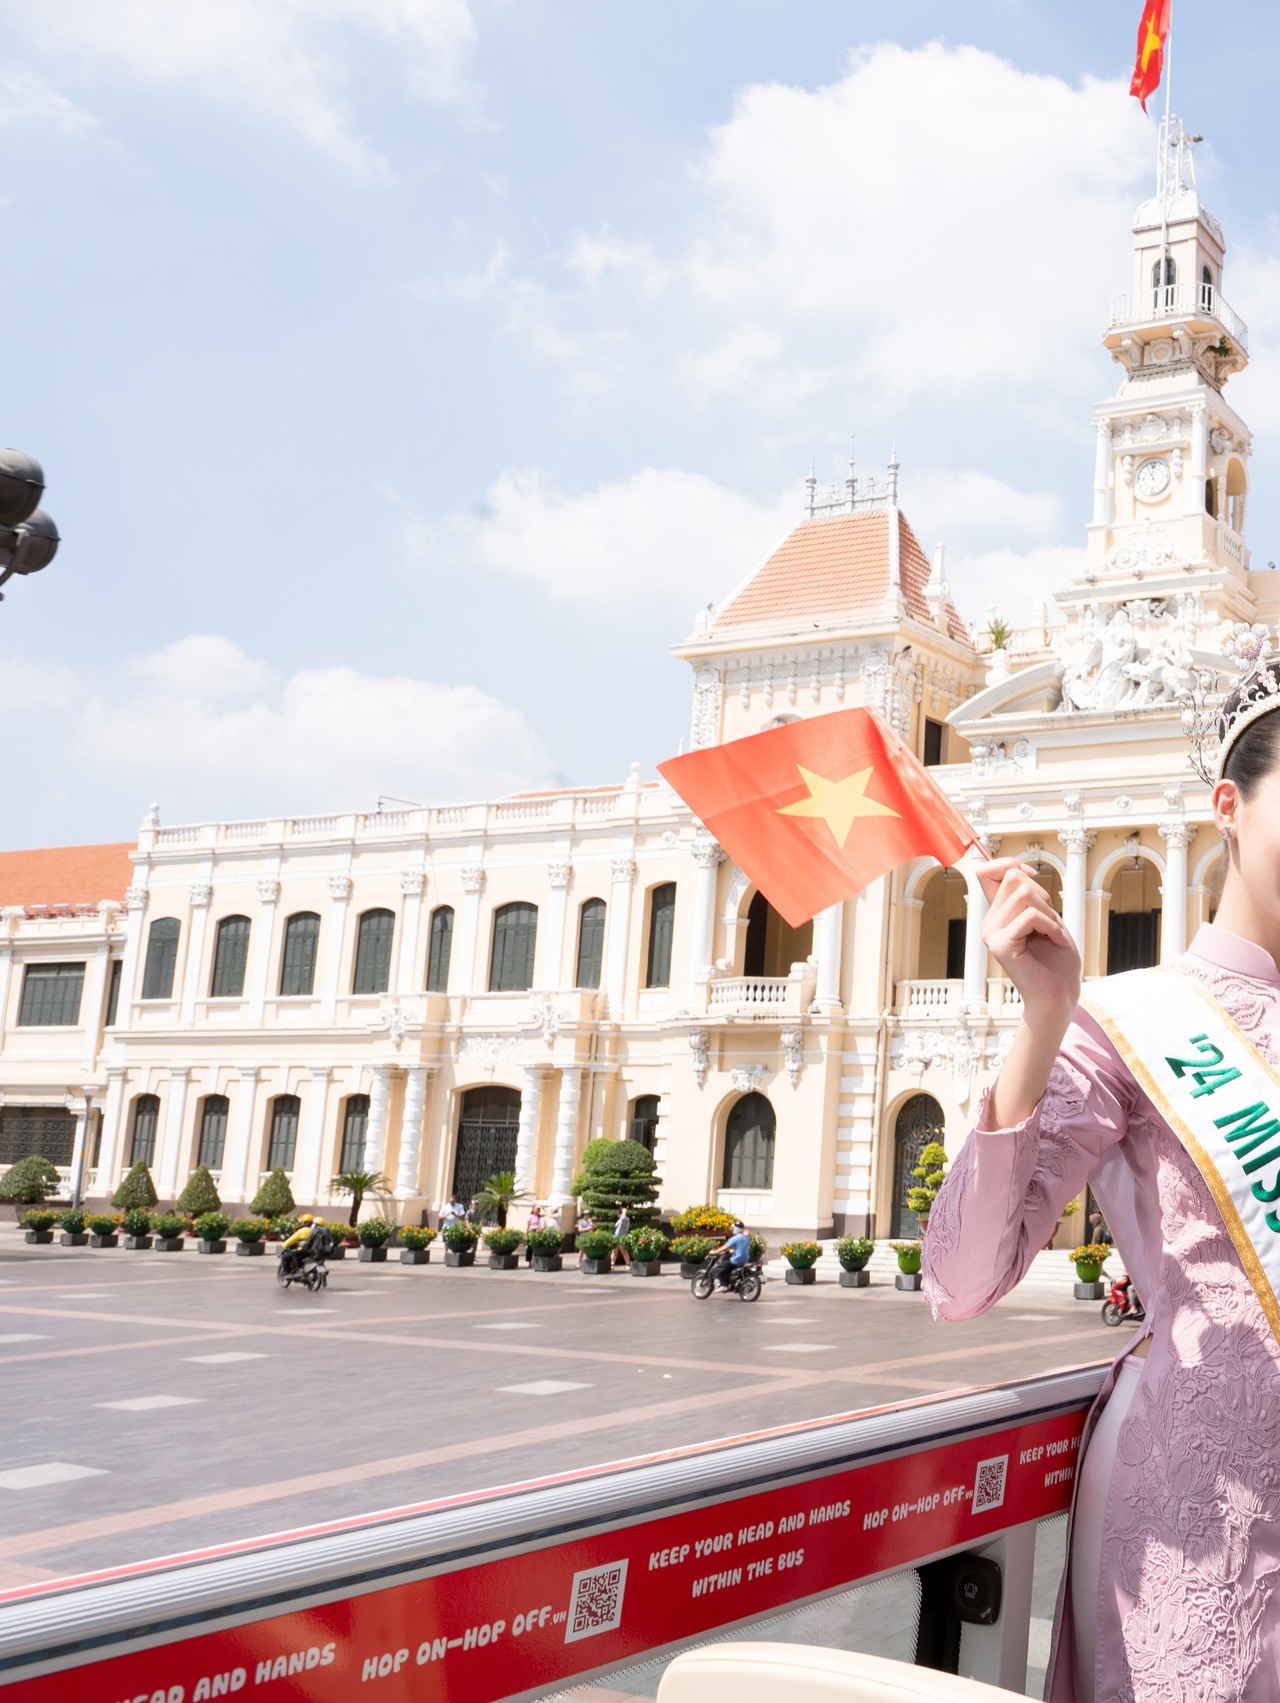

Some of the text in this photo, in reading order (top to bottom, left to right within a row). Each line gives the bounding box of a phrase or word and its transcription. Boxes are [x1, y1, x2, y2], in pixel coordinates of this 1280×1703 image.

[1167, 1034, 1242, 1098] '24
[1020, 1435, 1082, 1465] KEEP YOUR HE
[1044, 1466, 1074, 1488] WITHIN
[648, 1499, 851, 1571] KEEP YOUR HEAD AND HANDS
[863, 1508, 889, 1531] HOP
[692, 1548, 805, 1599] WITHIN THE BUS
[193, 1667, 247, 1702] AND
[255, 1642, 337, 1684] HANDS
[362, 1649, 409, 1682] HOP
